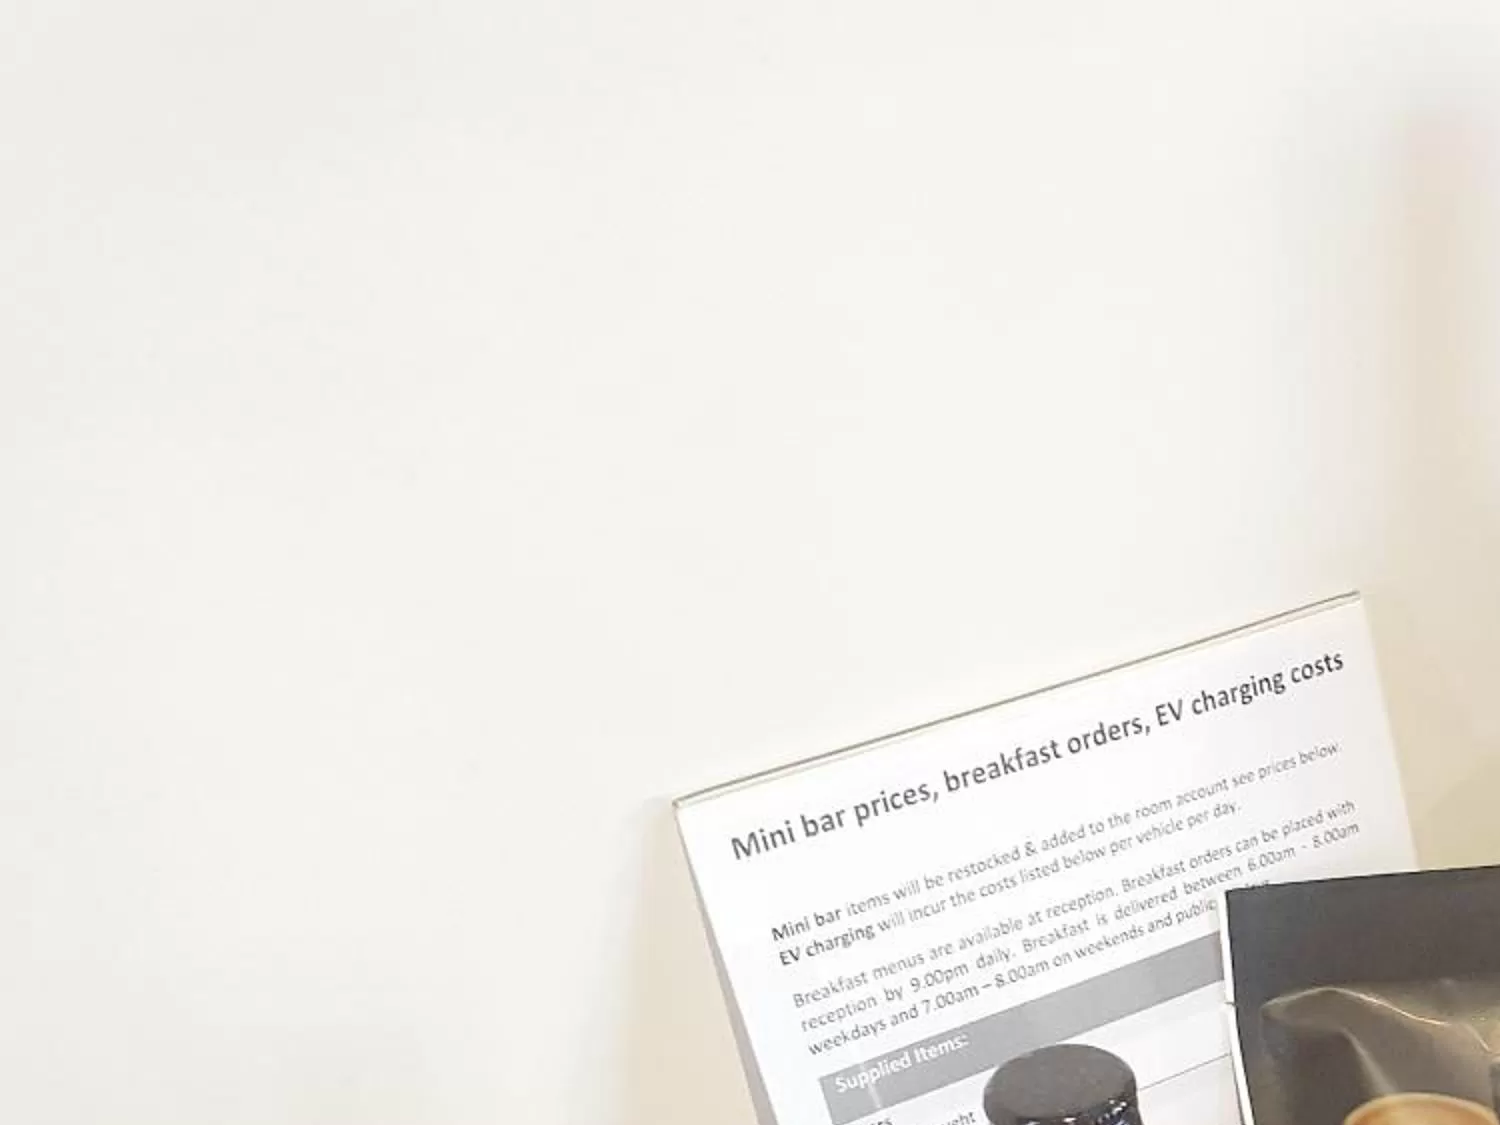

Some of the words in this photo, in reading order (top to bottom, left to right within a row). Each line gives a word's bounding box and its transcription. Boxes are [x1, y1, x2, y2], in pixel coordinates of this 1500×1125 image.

[729, 818, 797, 861] Mini
[798, 807, 846, 839] bar
[851, 782, 939, 828] prices,
[941, 738, 1064, 793] breakfast
[1065, 715, 1151, 755] orders,
[1153, 696, 1184, 728] EV
[1190, 670, 1288, 716] charging
[1289, 651, 1345, 685] costs
[769, 914, 811, 942] Mini
[811, 907, 842, 928] bar
[845, 892, 891, 917] items
[891, 878, 921, 901] will
[922, 874, 945, 891] be
[946, 845, 1021, 883] restocked
[1040, 822, 1087, 852] added
[1087, 820, 1105, 836] to
[1106, 811, 1131, 829] the
[1134, 798, 1173, 819] room
[1174, 777, 1230, 807] account
[1230, 770, 1256, 789] see
[1256, 755, 1297, 781] prices
[777, 944, 801, 967] EV
[804, 923, 876, 958] charging
[875, 910, 905, 932] will
[906, 898, 947, 923] incur
[948, 890, 976, 908] the
[977, 874, 1018, 898] costs
[1018, 857, 1061, 884] listed
[1060, 845, 1106, 869] below
[1108, 835, 1133, 857] per
[1134, 816, 1184, 844] vehicle
[1185, 809, 1209, 829] per
[791, 970, 869, 1009] Breakfast
[870, 952, 925, 981] menus
[928, 942, 953, 961] are
[958, 916, 1023, 951] available
[1026, 910, 1044, 927] at
[1120, 859, 1187, 893] Breakfast
[1187, 844, 1233, 869] orders
[1234, 834, 1259, 853] can
[1259, 827, 1279, 843] be
[1280, 808, 1325, 839] placed
[1324, 798, 1356, 821] with
[835, 1051, 914, 1094] Supplied
[914, 1033, 971, 1062] Items:
